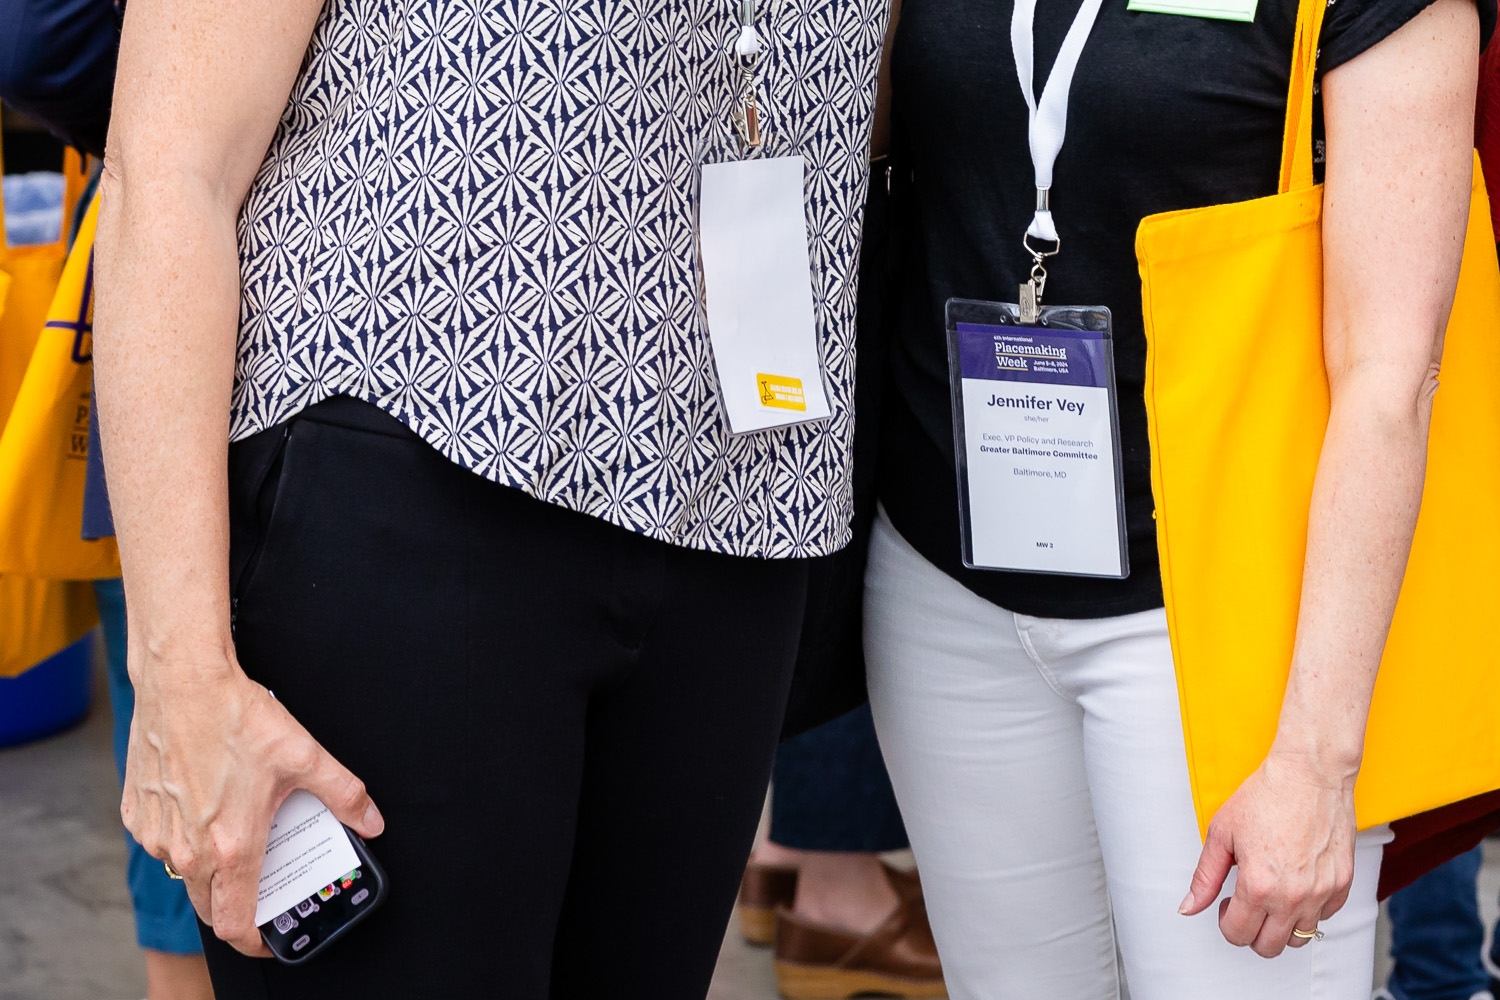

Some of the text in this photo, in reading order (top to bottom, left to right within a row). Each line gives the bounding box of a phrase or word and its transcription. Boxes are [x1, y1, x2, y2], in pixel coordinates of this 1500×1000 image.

[994, 342, 1067, 360] Placemaking
[996, 356, 1028, 368] Week
[987, 394, 1086, 416] Jennifer Vey
[1024, 415, 1049, 423] she/her
[982, 433, 1003, 441] Exec.
[1016, 435, 1039, 445] Policy
[1041, 437, 1056, 445] and
[1057, 438, 1094, 448] Research
[980, 445, 1098, 460] Greater Baltimore Committee
[1013, 468, 1067, 479] Baltimore, MD
